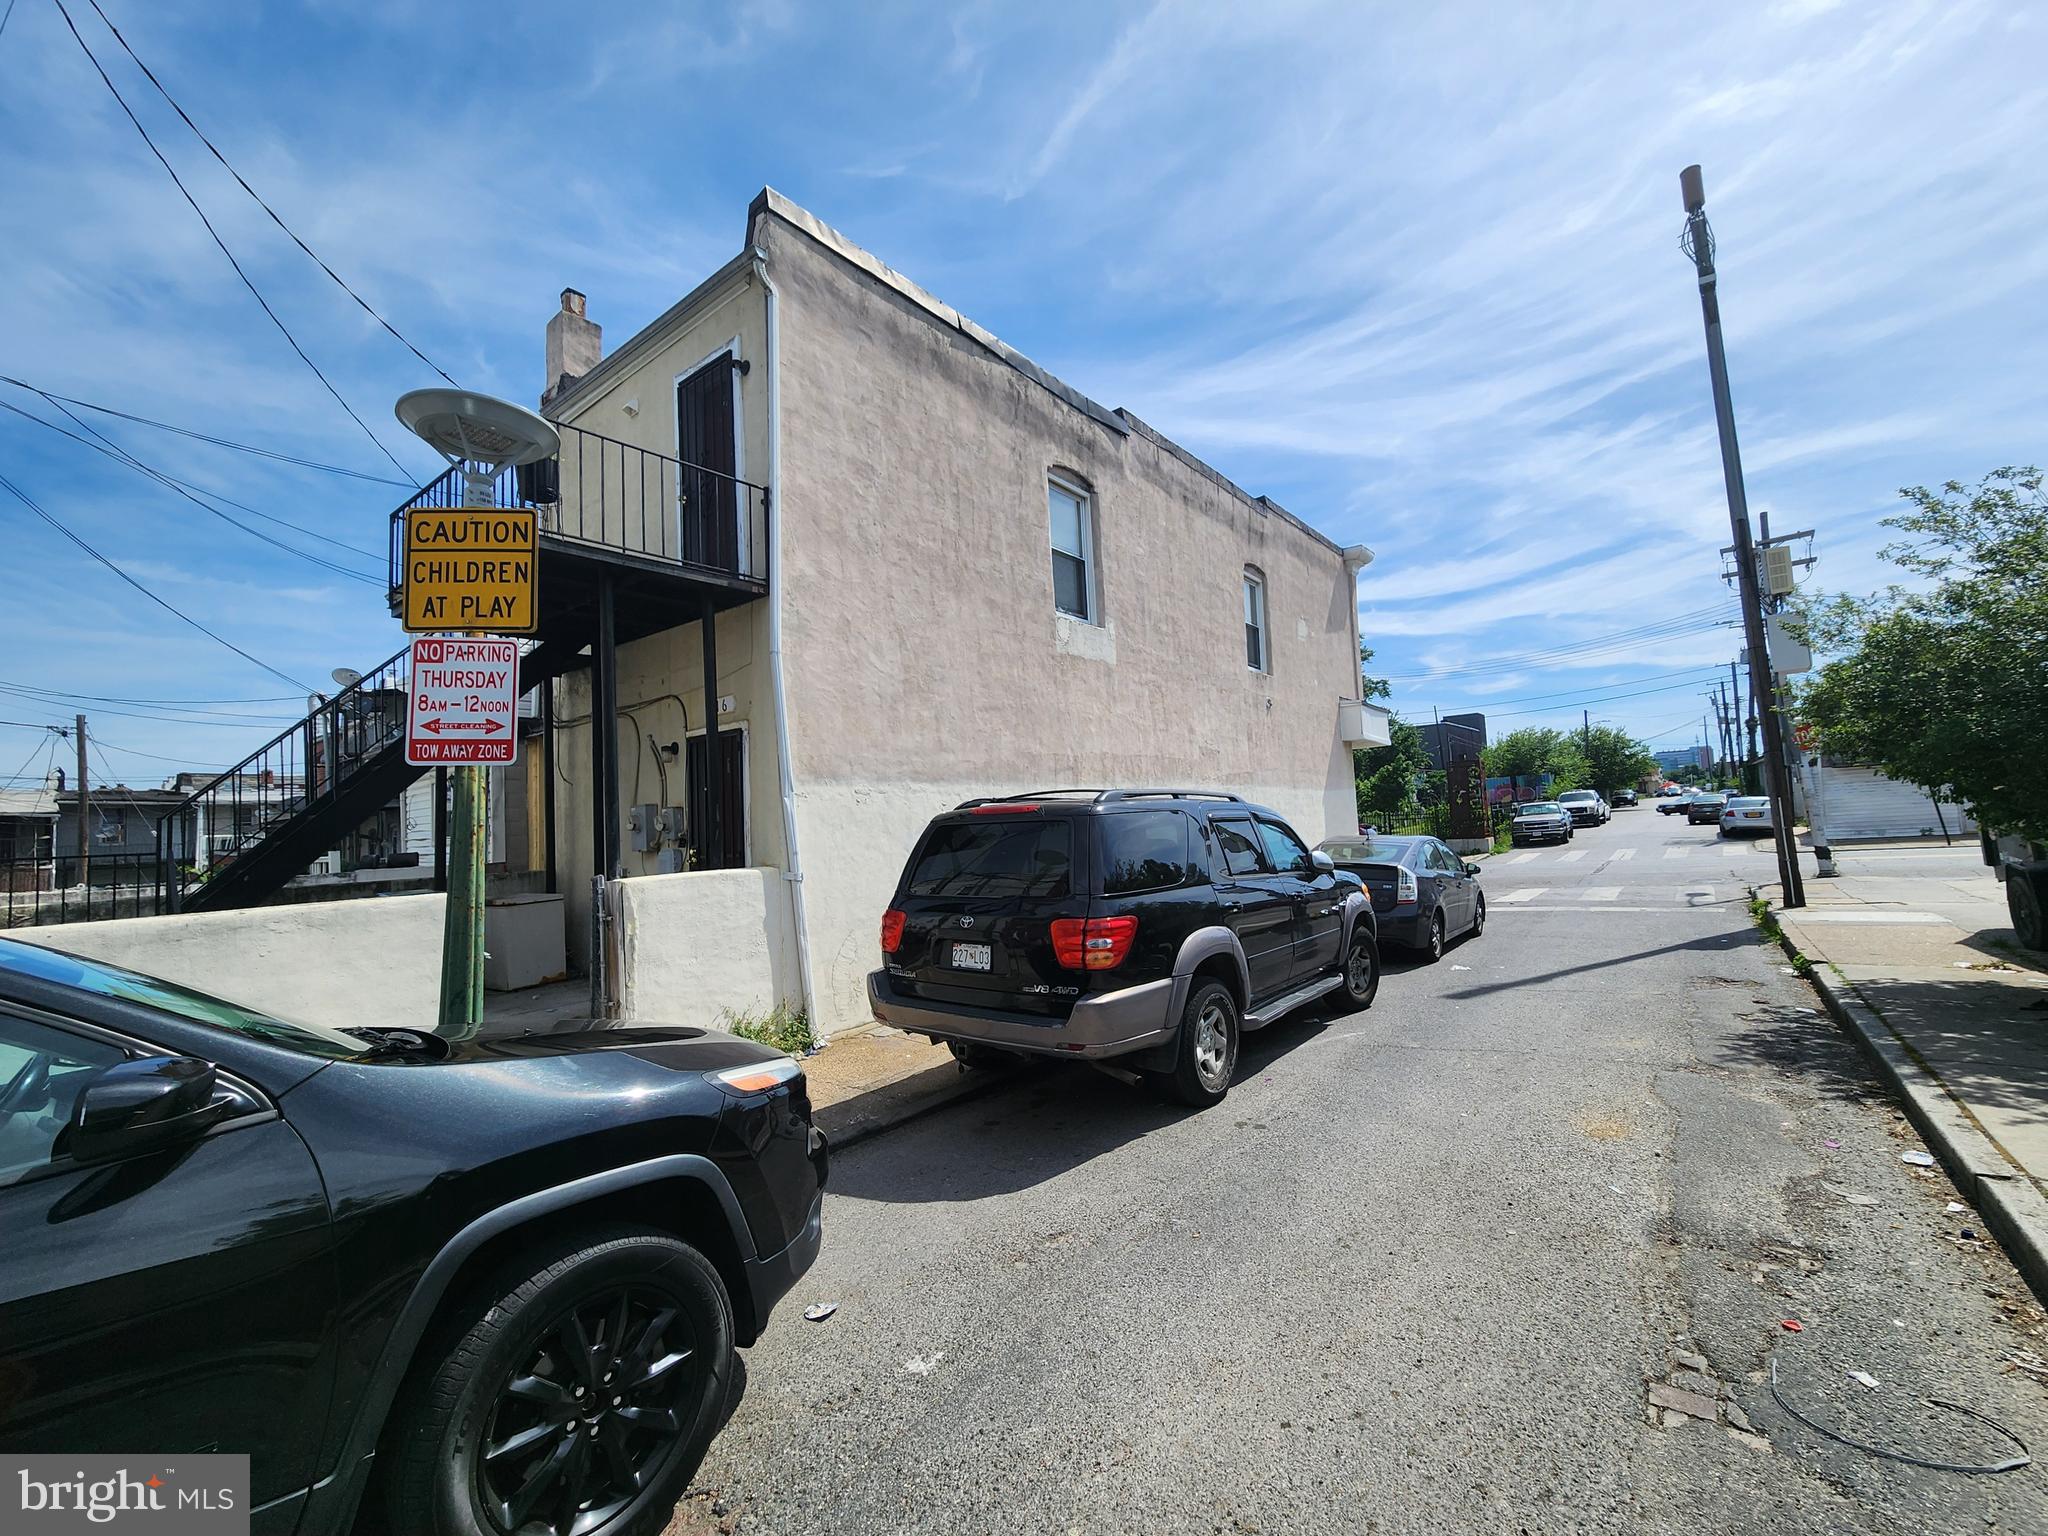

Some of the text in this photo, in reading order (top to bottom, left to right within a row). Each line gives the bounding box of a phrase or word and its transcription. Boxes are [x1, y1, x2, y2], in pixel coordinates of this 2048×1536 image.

[415, 521, 529, 543] CAUTION
[413, 561, 529, 584] CHILDREN
[422, 596, 516, 618] AT PLAY
[416, 643, 511, 663] NO PARKING
[422, 670, 507, 688] THURSDAY
[418, 694, 447, 712] 8AM
[416, 744, 508, 759] TOW AWAY ZONE
[1033, 984, 1050, 993] V8
